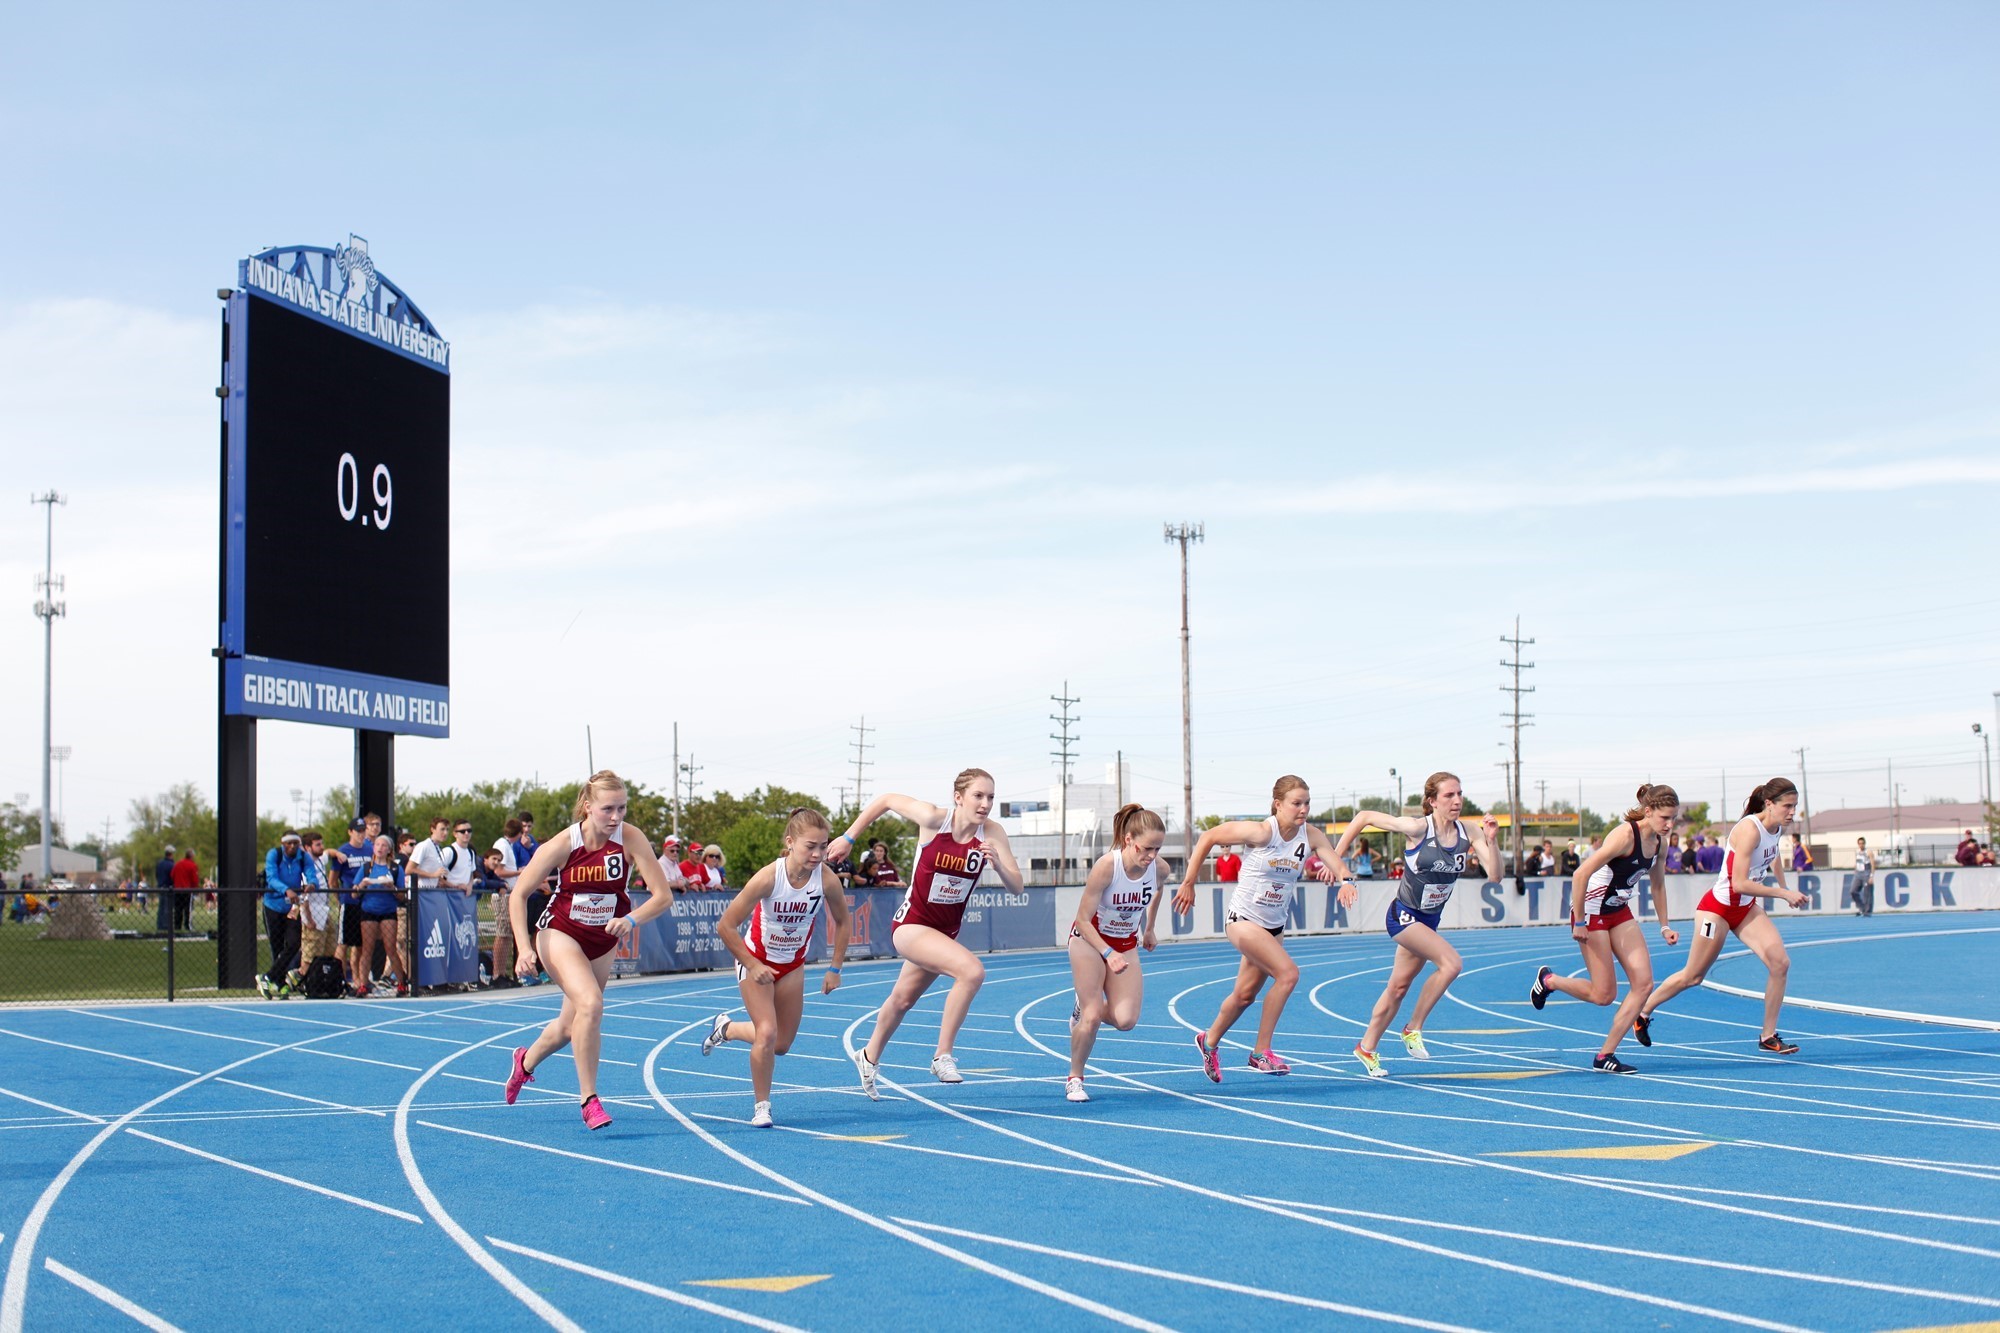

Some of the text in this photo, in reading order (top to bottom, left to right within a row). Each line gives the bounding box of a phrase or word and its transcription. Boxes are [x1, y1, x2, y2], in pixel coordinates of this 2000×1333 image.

[248, 257, 450, 367] INDIANA STATE UNIVERSITY
[337, 452, 392, 530] 0.9
[244, 673, 448, 727] GIBSON TRACK AND FIELD
[1294, 842, 1305, 861] 4
[607, 856, 621, 878] 8
[934, 850, 967, 872] LOYO
[967, 851, 980, 872] 6
[1454, 855, 1465, 872] 3
[940, 886, 962, 895] Falsey
[1141, 887, 1152, 905] 5
[1265, 891, 1283, 900] Finley
[809, 896, 821, 914] 7
[996, 893, 1003, 907] &
[1005, 893, 1029, 906] FIELD
[1112, 892, 1141, 905] ILLIN
[572, 905, 614, 914] Michaelson
[773, 902, 808, 914] ILLINO
[967, 912, 982, 922] 2015
[1110, 920, 1134, 928] Sanden
[1704, 922, 1712, 937] 1
[675, 939, 690, 953] 2011
[694, 939, 710, 952] 2012
[770, 934, 803, 943] Knoblock
[423, 943, 446, 959] adidas
